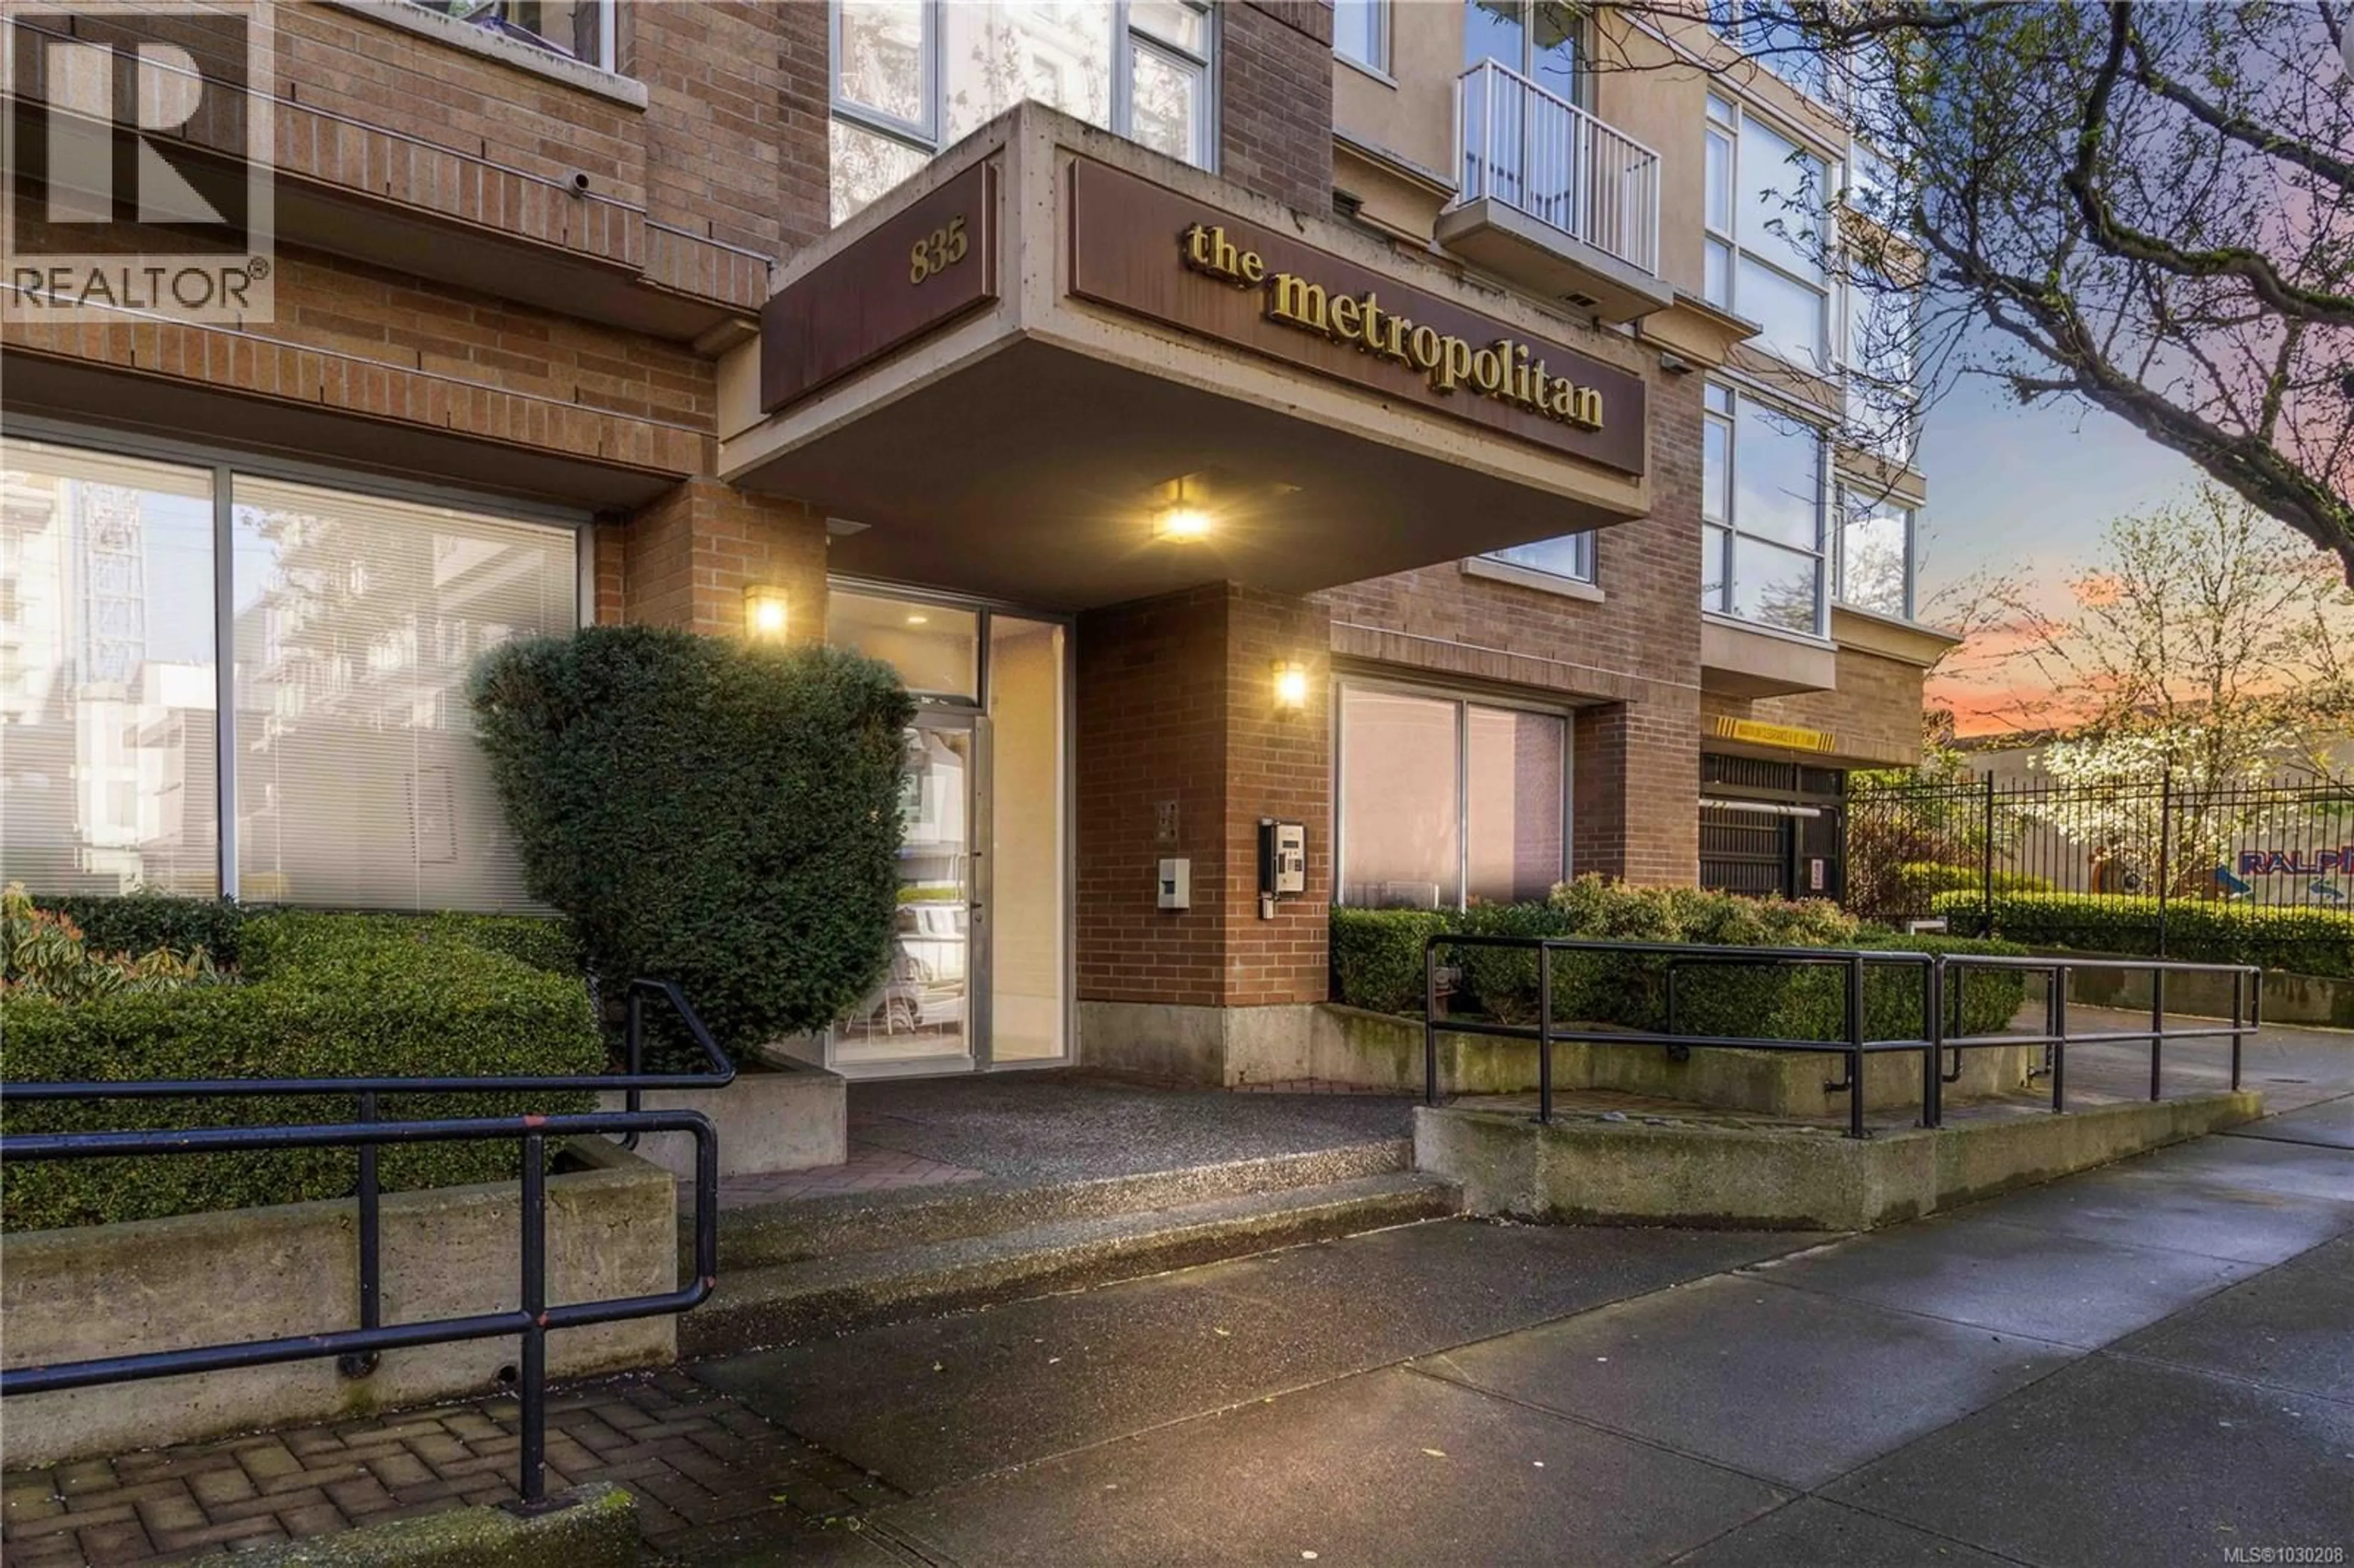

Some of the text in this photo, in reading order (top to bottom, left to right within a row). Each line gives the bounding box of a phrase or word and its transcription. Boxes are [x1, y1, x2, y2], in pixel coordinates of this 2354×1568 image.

[910, 213, 967, 284] 835
[1186, 222, 1604, 432] the metropolitan
